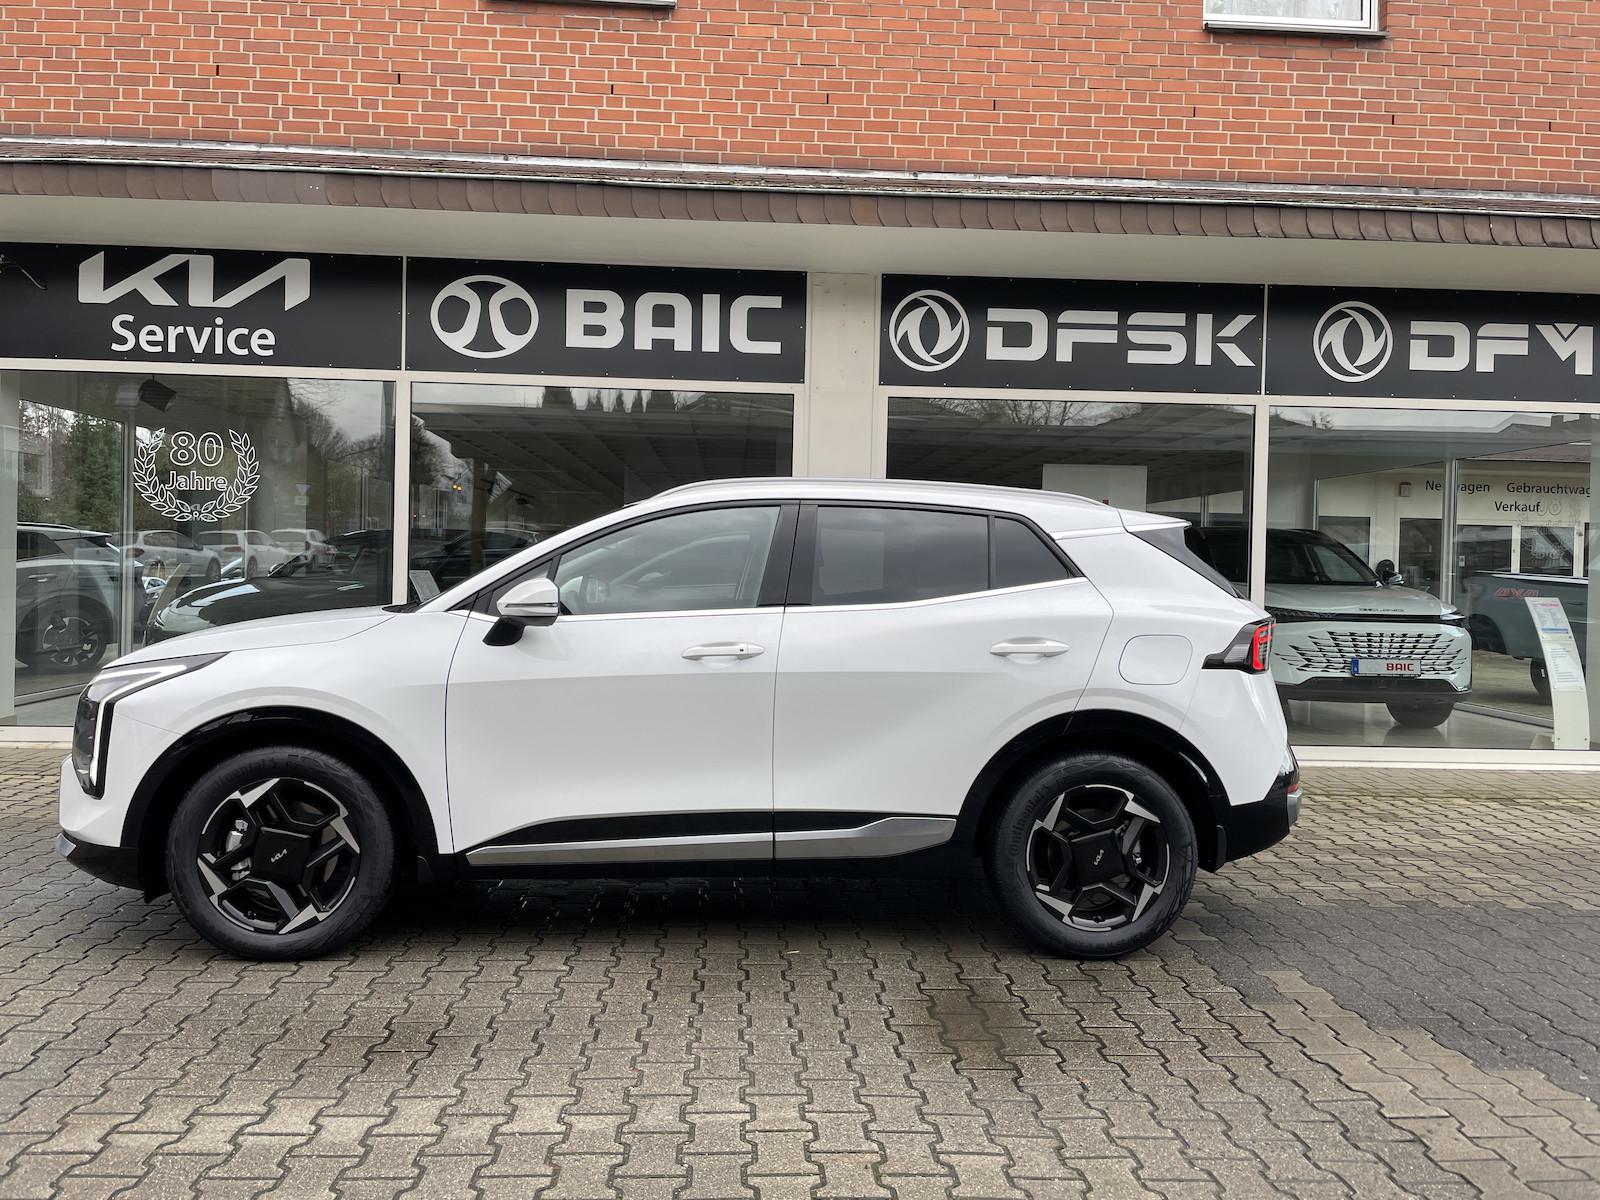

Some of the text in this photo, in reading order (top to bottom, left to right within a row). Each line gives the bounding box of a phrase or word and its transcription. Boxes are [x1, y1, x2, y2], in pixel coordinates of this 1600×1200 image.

[78, 250, 311, 311] KIA
[110, 313, 276, 357] Service
[565, 288, 782, 355] BAIC
[986, 307, 1257, 367] DFSK
[169, 431, 224, 467] 80
[165, 470, 228, 491] Jahre
[1493, 500, 1541, 512] Verkauf
[1386, 662, 1415, 672] BAIC
